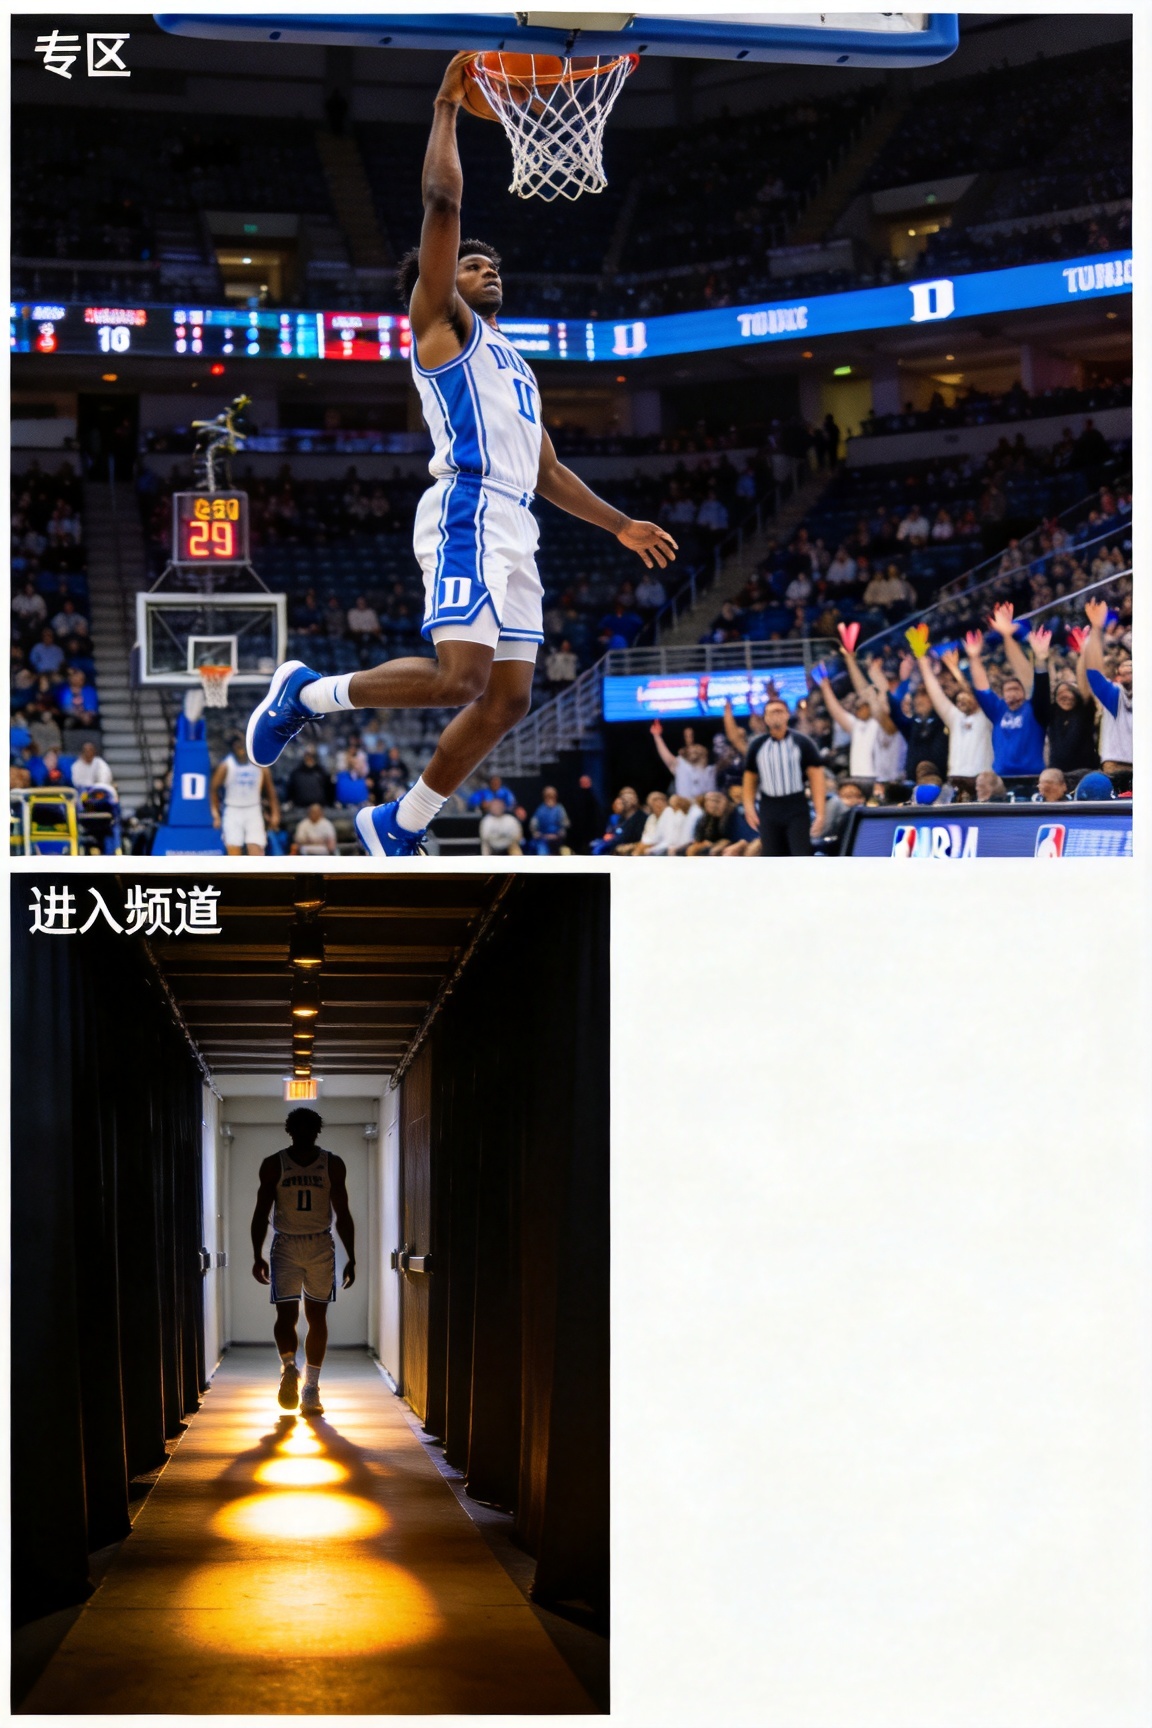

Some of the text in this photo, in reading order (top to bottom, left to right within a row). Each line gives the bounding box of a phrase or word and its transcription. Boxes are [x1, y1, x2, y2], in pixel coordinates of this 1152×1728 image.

[908, 279, 956, 322] D
[189, 520, 233, 557] 29
[438, 576, 473, 610] D
